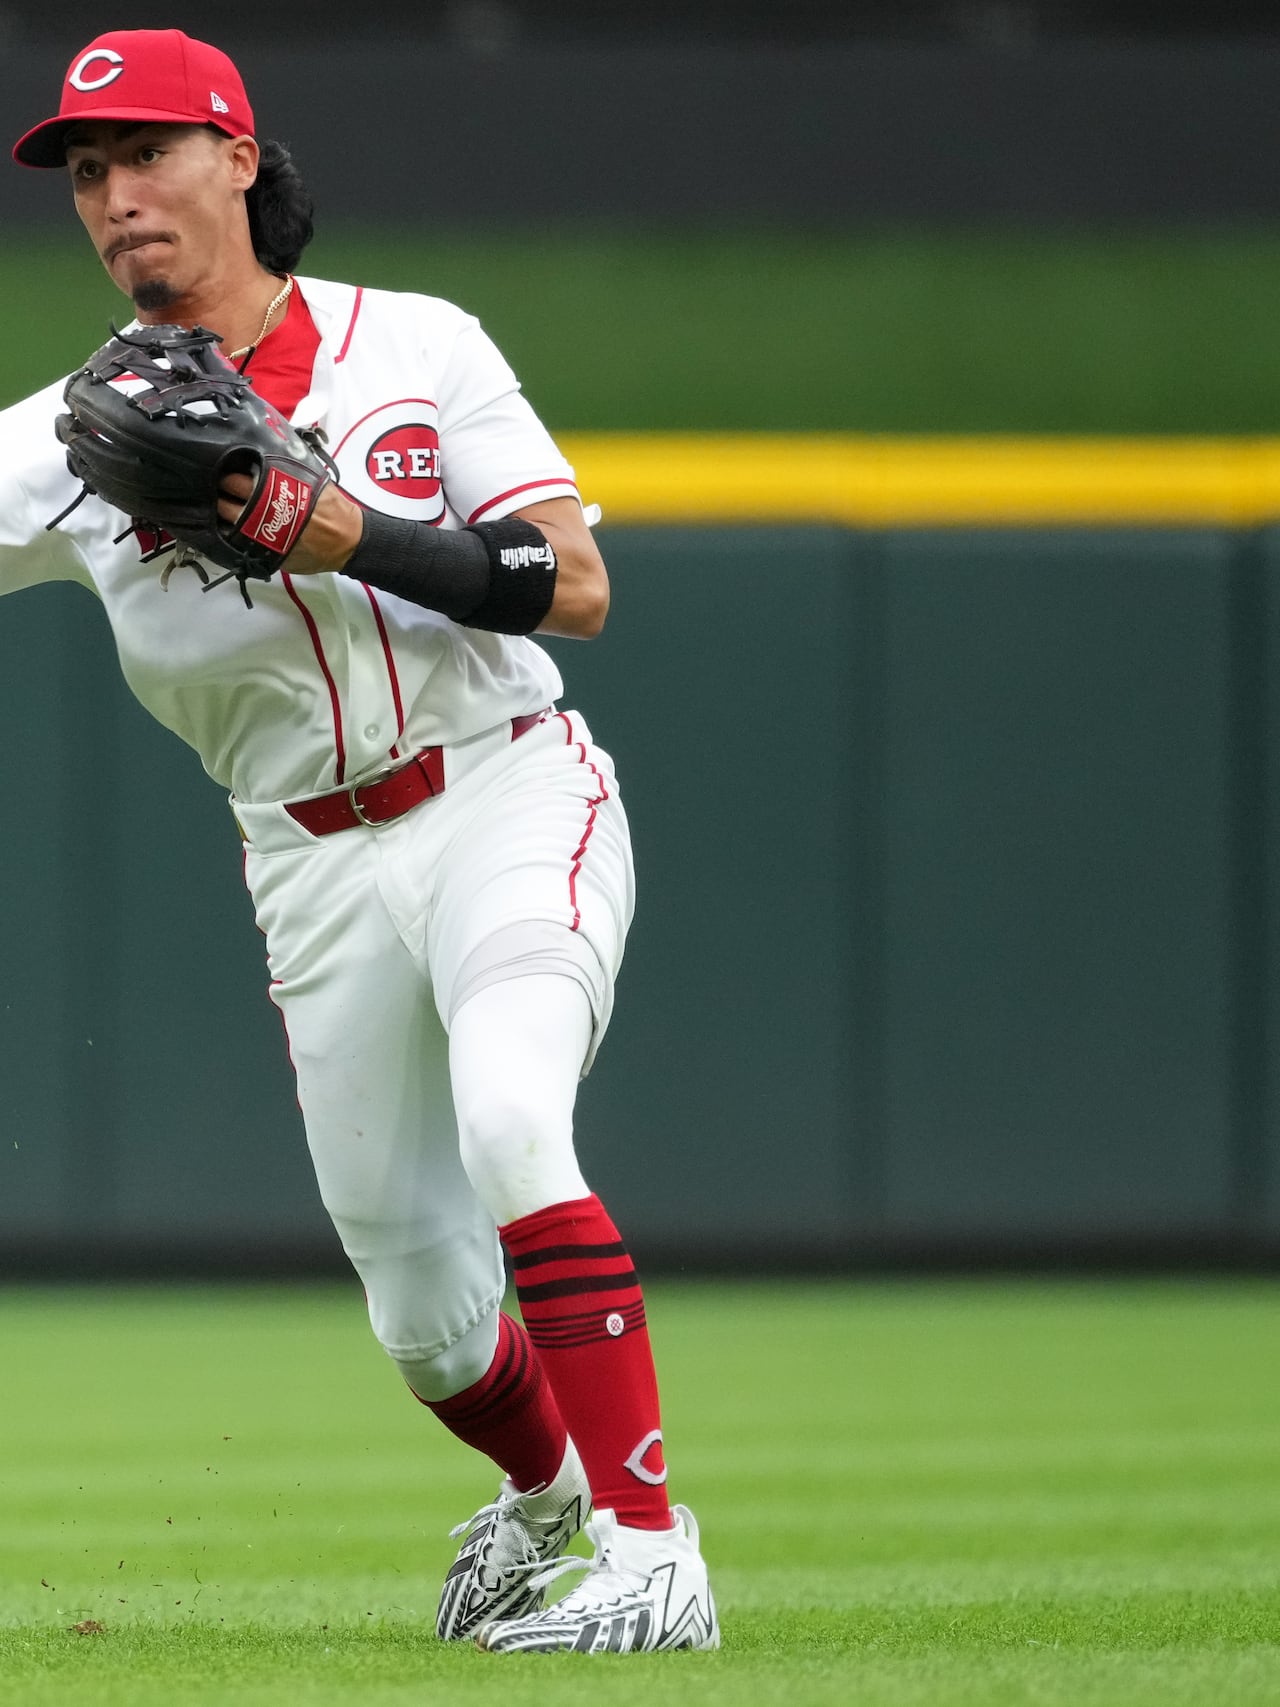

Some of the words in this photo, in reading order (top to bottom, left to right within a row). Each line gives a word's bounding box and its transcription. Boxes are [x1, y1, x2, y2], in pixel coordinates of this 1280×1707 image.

[68, 48, 124, 92] C
[261, 479, 295, 542] Rawlings
[500, 542, 556, 571] Franklin
